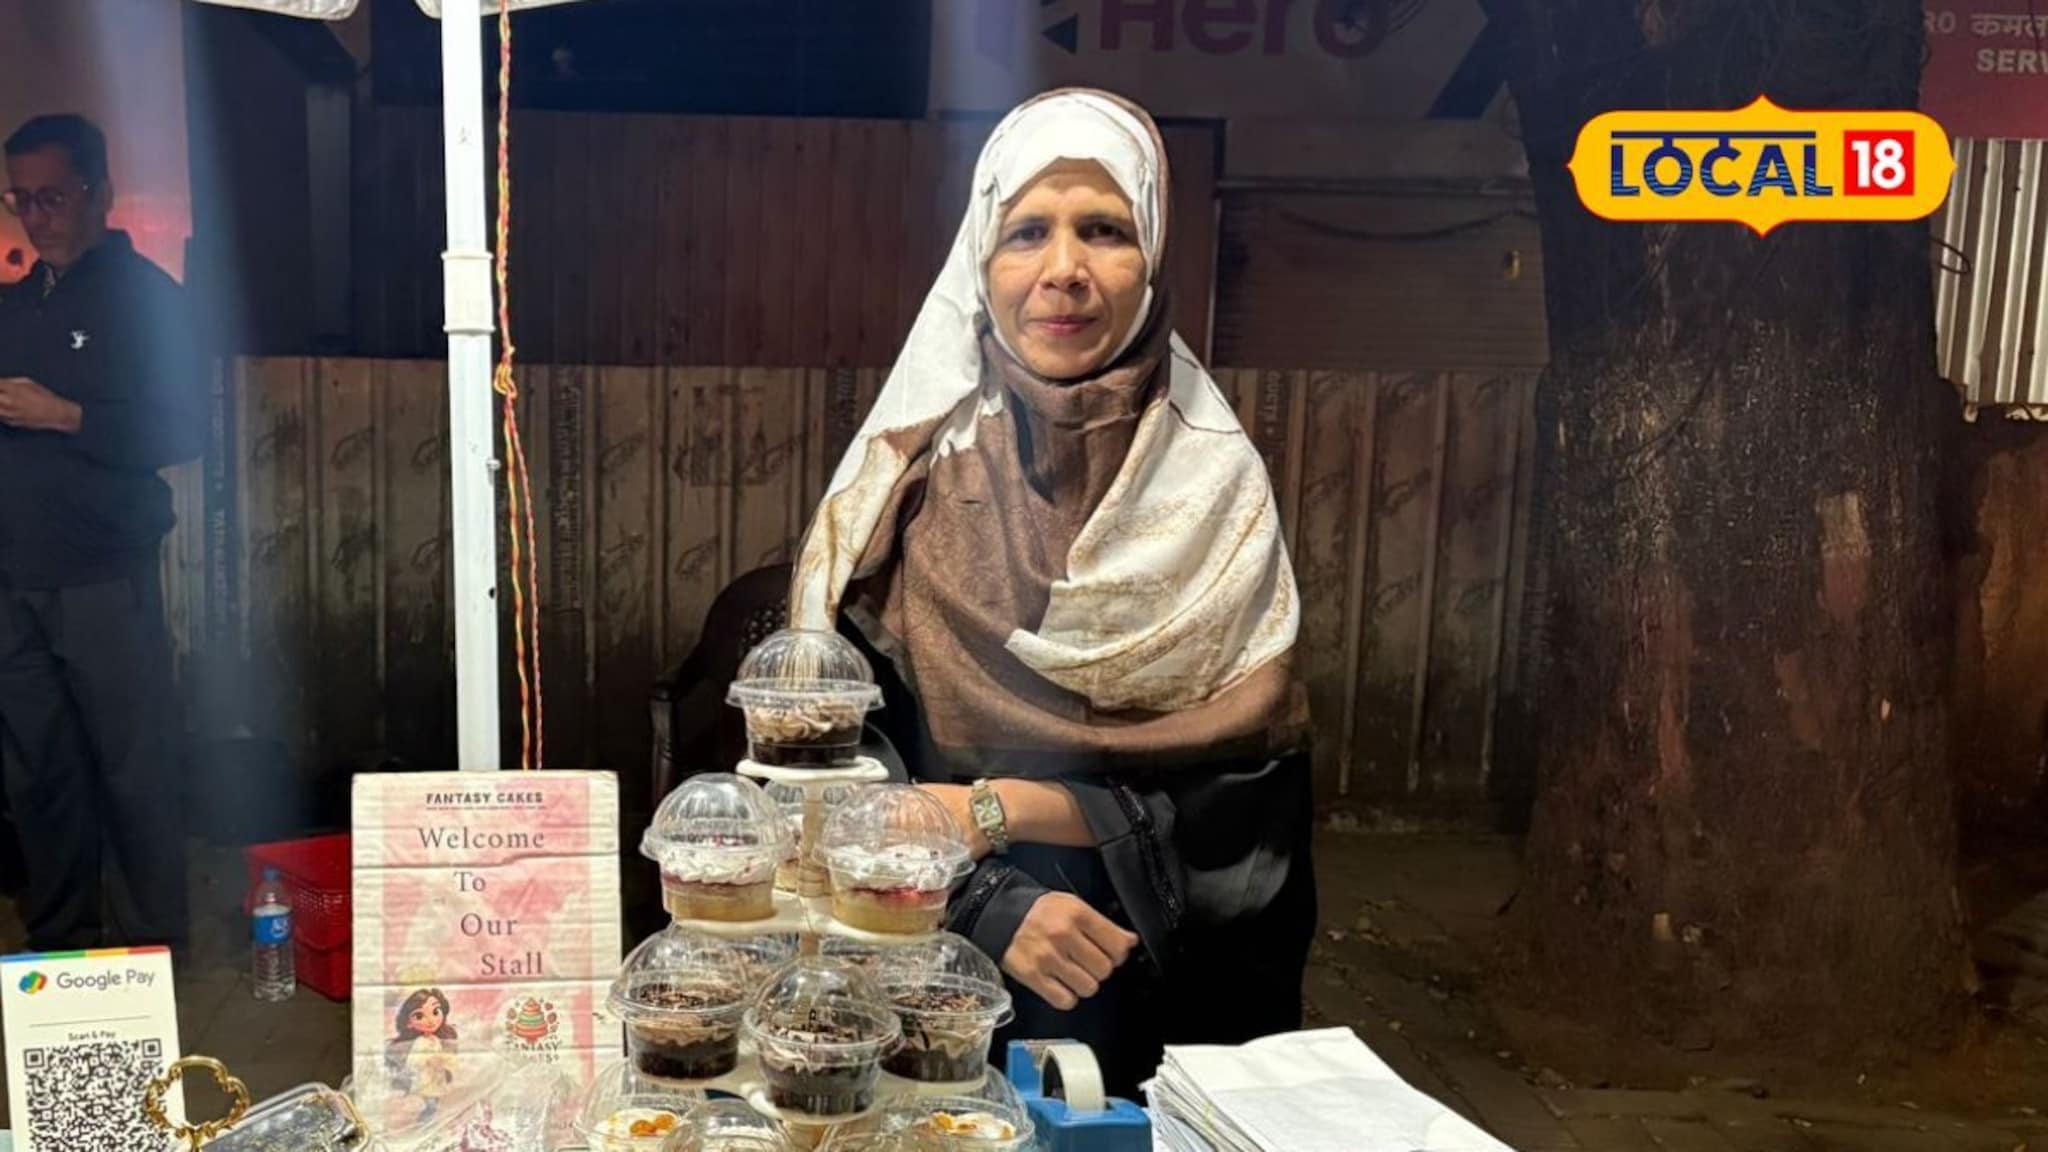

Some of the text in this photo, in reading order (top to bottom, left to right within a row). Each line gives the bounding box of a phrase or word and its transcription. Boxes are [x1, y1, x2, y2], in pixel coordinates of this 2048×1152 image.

[1099, 0, 1384, 59] Hero
[426, 791, 544, 805] FANTASY CAKES
[418, 825, 546, 849] Welcome
[453, 871, 487, 893] To
[460, 912, 518, 937] Our
[481, 951, 544, 976] Stall
[56, 968, 156, 991] Google Pay
[68, 1031, 90, 1042] Scan
[100, 1029, 117, 1040] Pay
